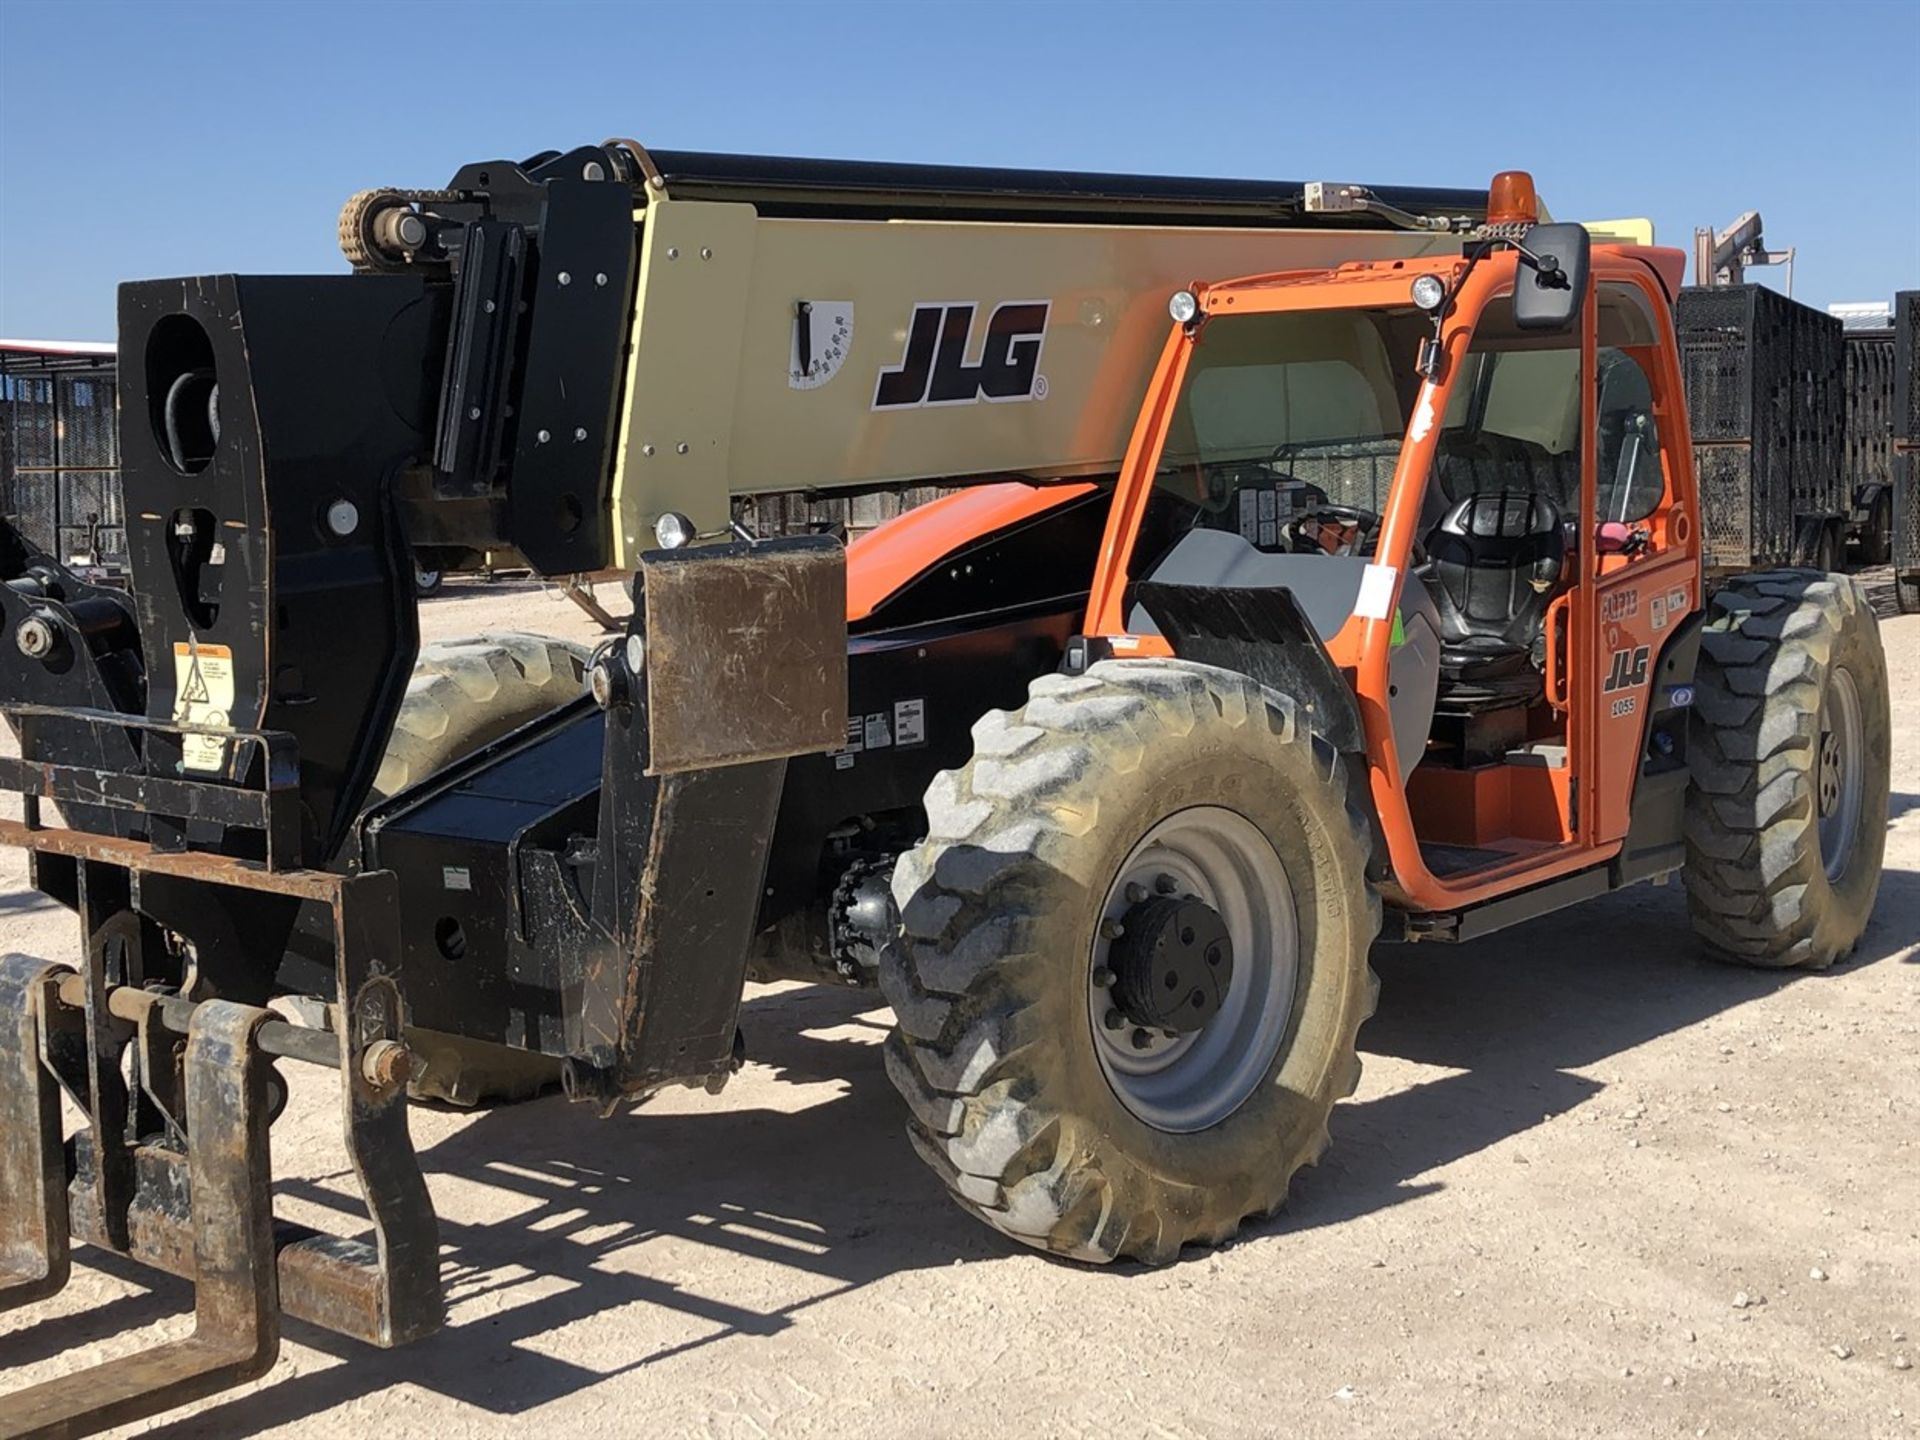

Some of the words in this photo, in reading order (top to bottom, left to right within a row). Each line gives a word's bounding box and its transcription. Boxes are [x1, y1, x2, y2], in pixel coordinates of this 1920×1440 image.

[873, 302, 1051, 409] JLG
[1604, 645, 1650, 692] JLG
[1612, 698, 1636, 717] 1055
